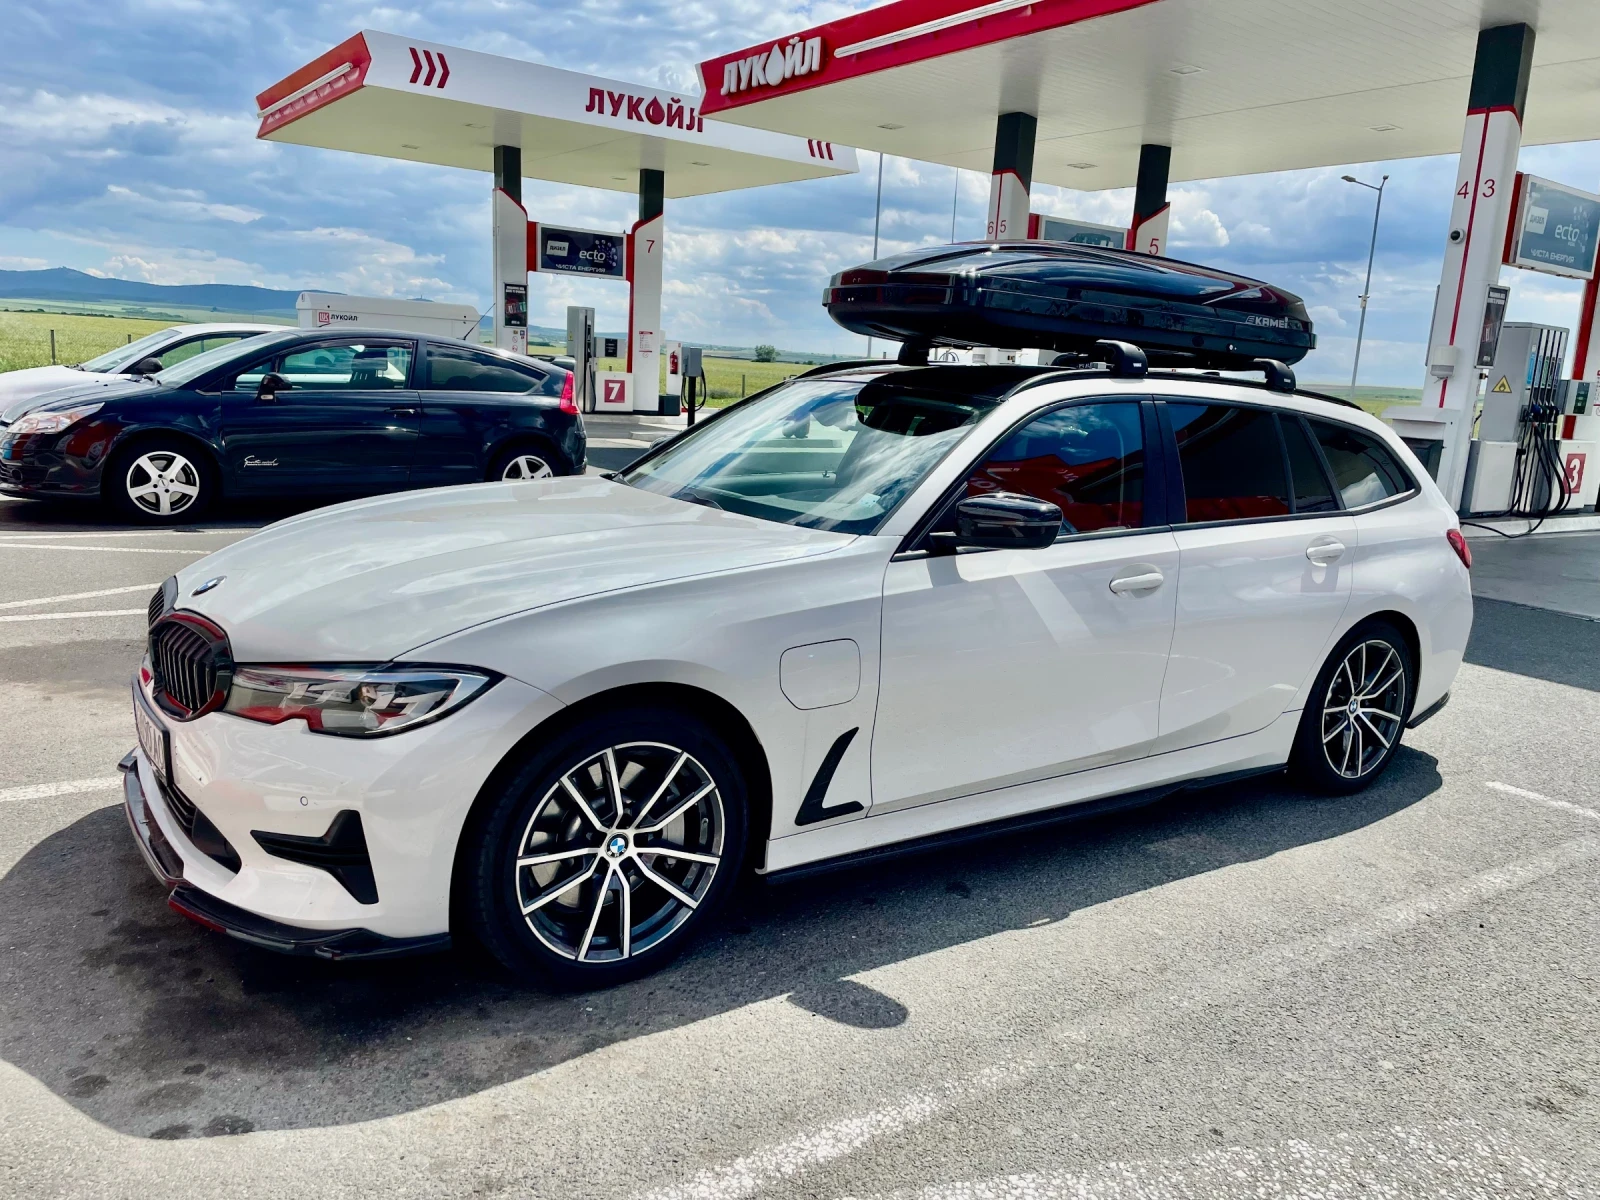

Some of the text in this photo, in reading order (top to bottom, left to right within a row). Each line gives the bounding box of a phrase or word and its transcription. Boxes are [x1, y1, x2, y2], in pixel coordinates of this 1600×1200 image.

[721, 37, 821, 96] ЛУКОЙЛ
[1457, 179, 1495, 199] 4 3
[987, 220, 1007, 235] 6 5
[1555, 223, 1580, 242] ecto
[578, 249, 606, 261] ecto
[646, 239, 655, 253] 7
[1149, 238, 1160, 256] 5
[608, 383, 621, 400] 7
[1569, 458, 1581, 489] 3
